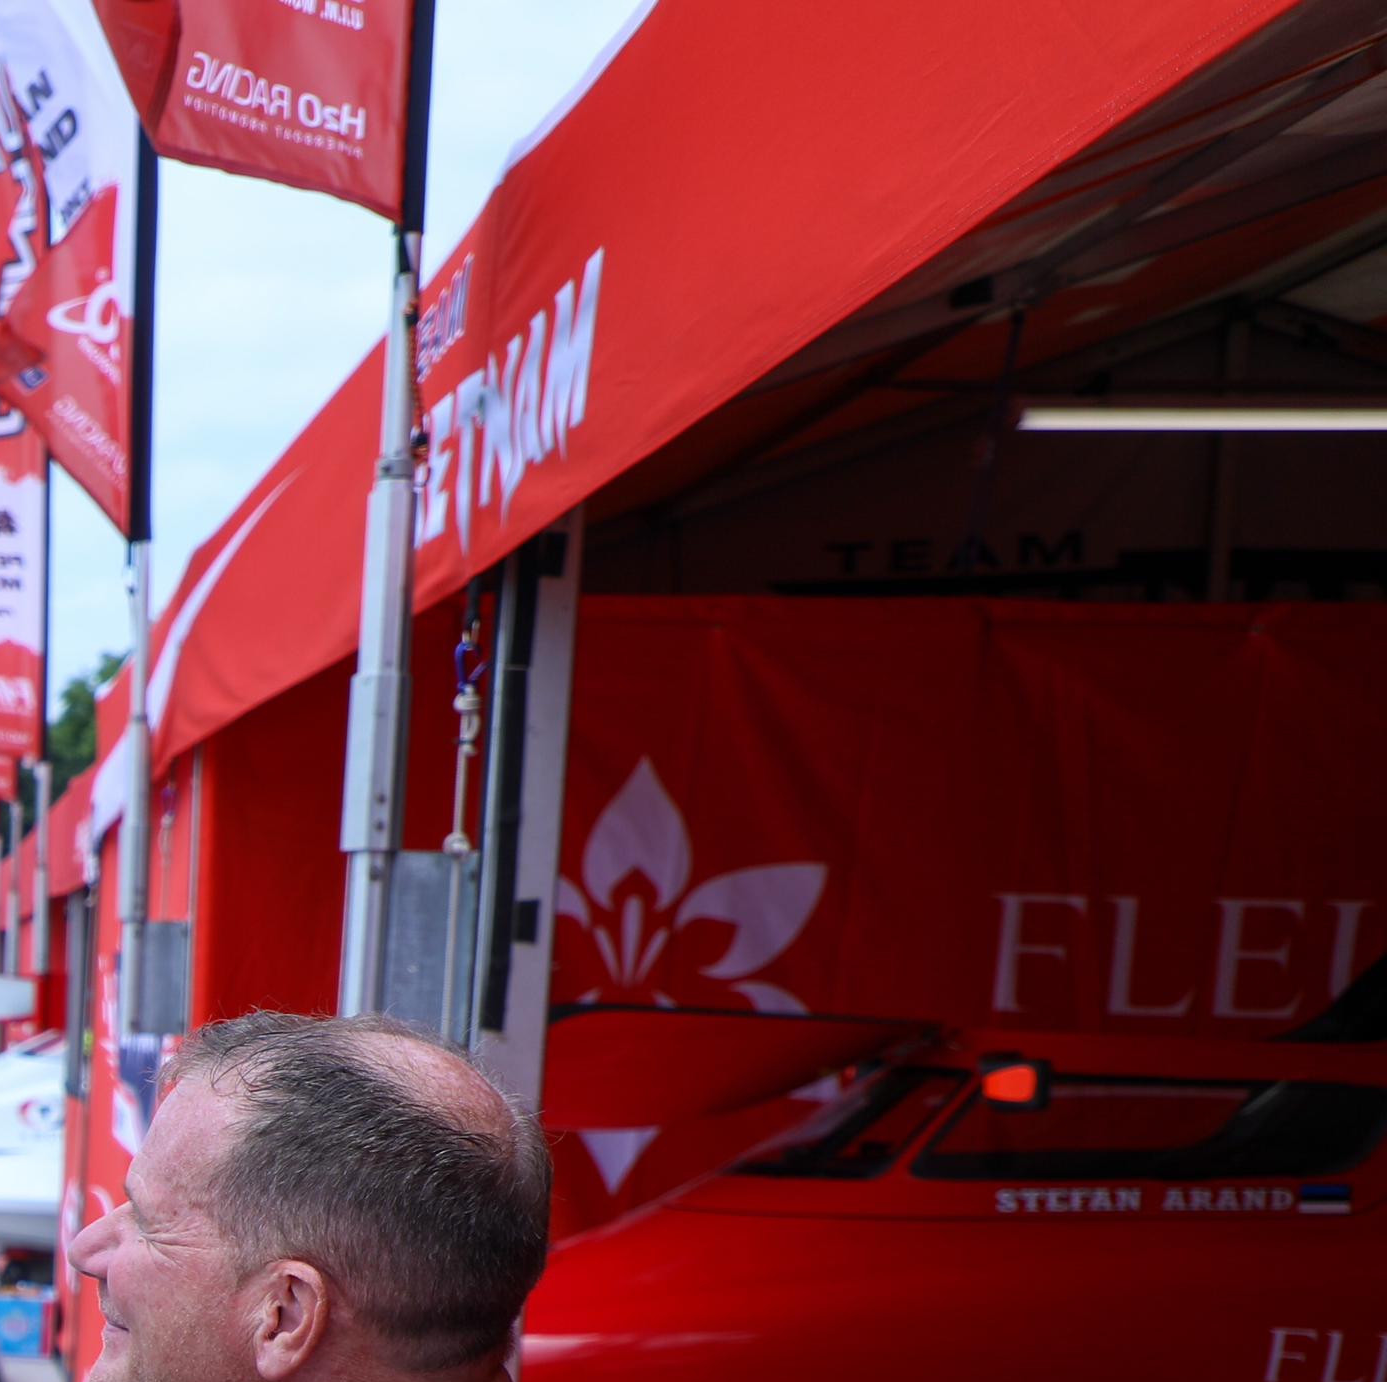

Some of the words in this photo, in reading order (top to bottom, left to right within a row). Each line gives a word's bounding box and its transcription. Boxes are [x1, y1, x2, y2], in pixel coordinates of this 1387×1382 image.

[414, 246, 605, 558] ETNAM
[825, 530, 1087, 576] TEAM
[995, 1187, 1141, 1214] STEFAN
[1163, 1186, 1296, 1212] ARAND
